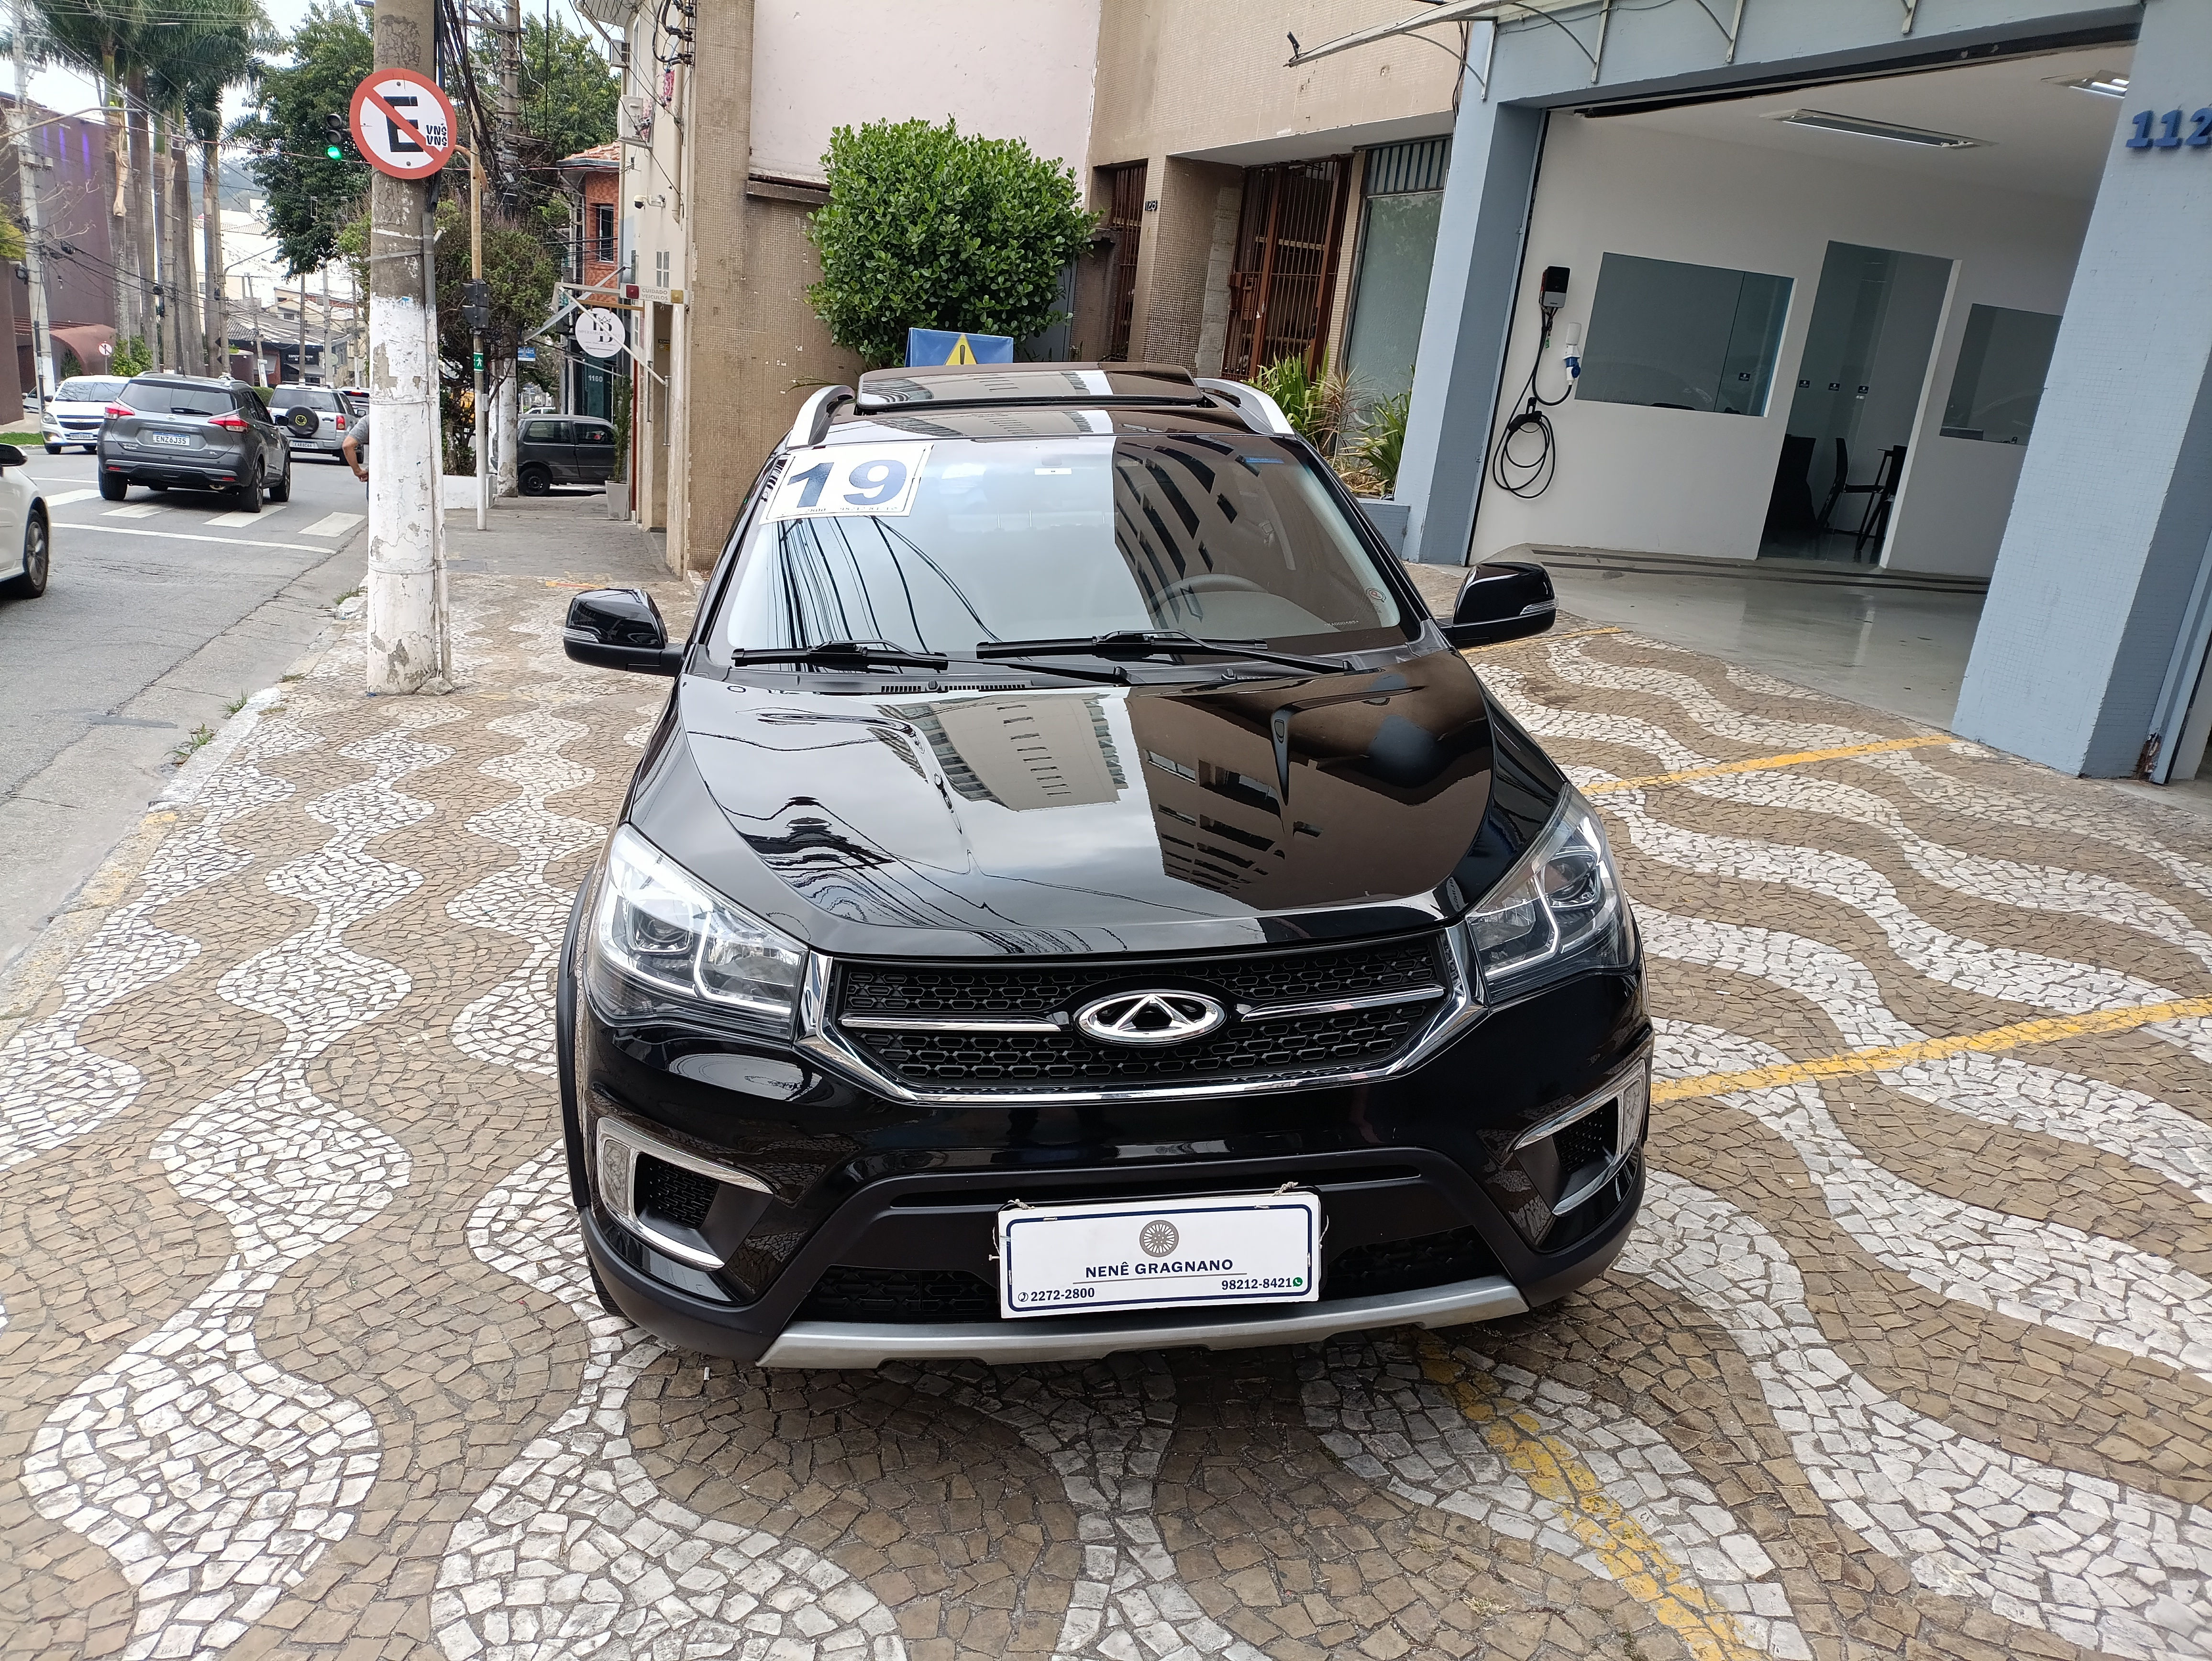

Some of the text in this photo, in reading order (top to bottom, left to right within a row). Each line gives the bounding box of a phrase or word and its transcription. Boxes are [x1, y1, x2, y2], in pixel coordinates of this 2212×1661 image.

[383, 96, 424, 152] E
[156, 435, 187, 444] ENZ6J35
[787, 459, 907, 508] 19
[1085, 1259, 1234, 1278] NENÊ GRAGNANO
[1030, 1277, 1292, 1302] 2272-2800 98212-8421
